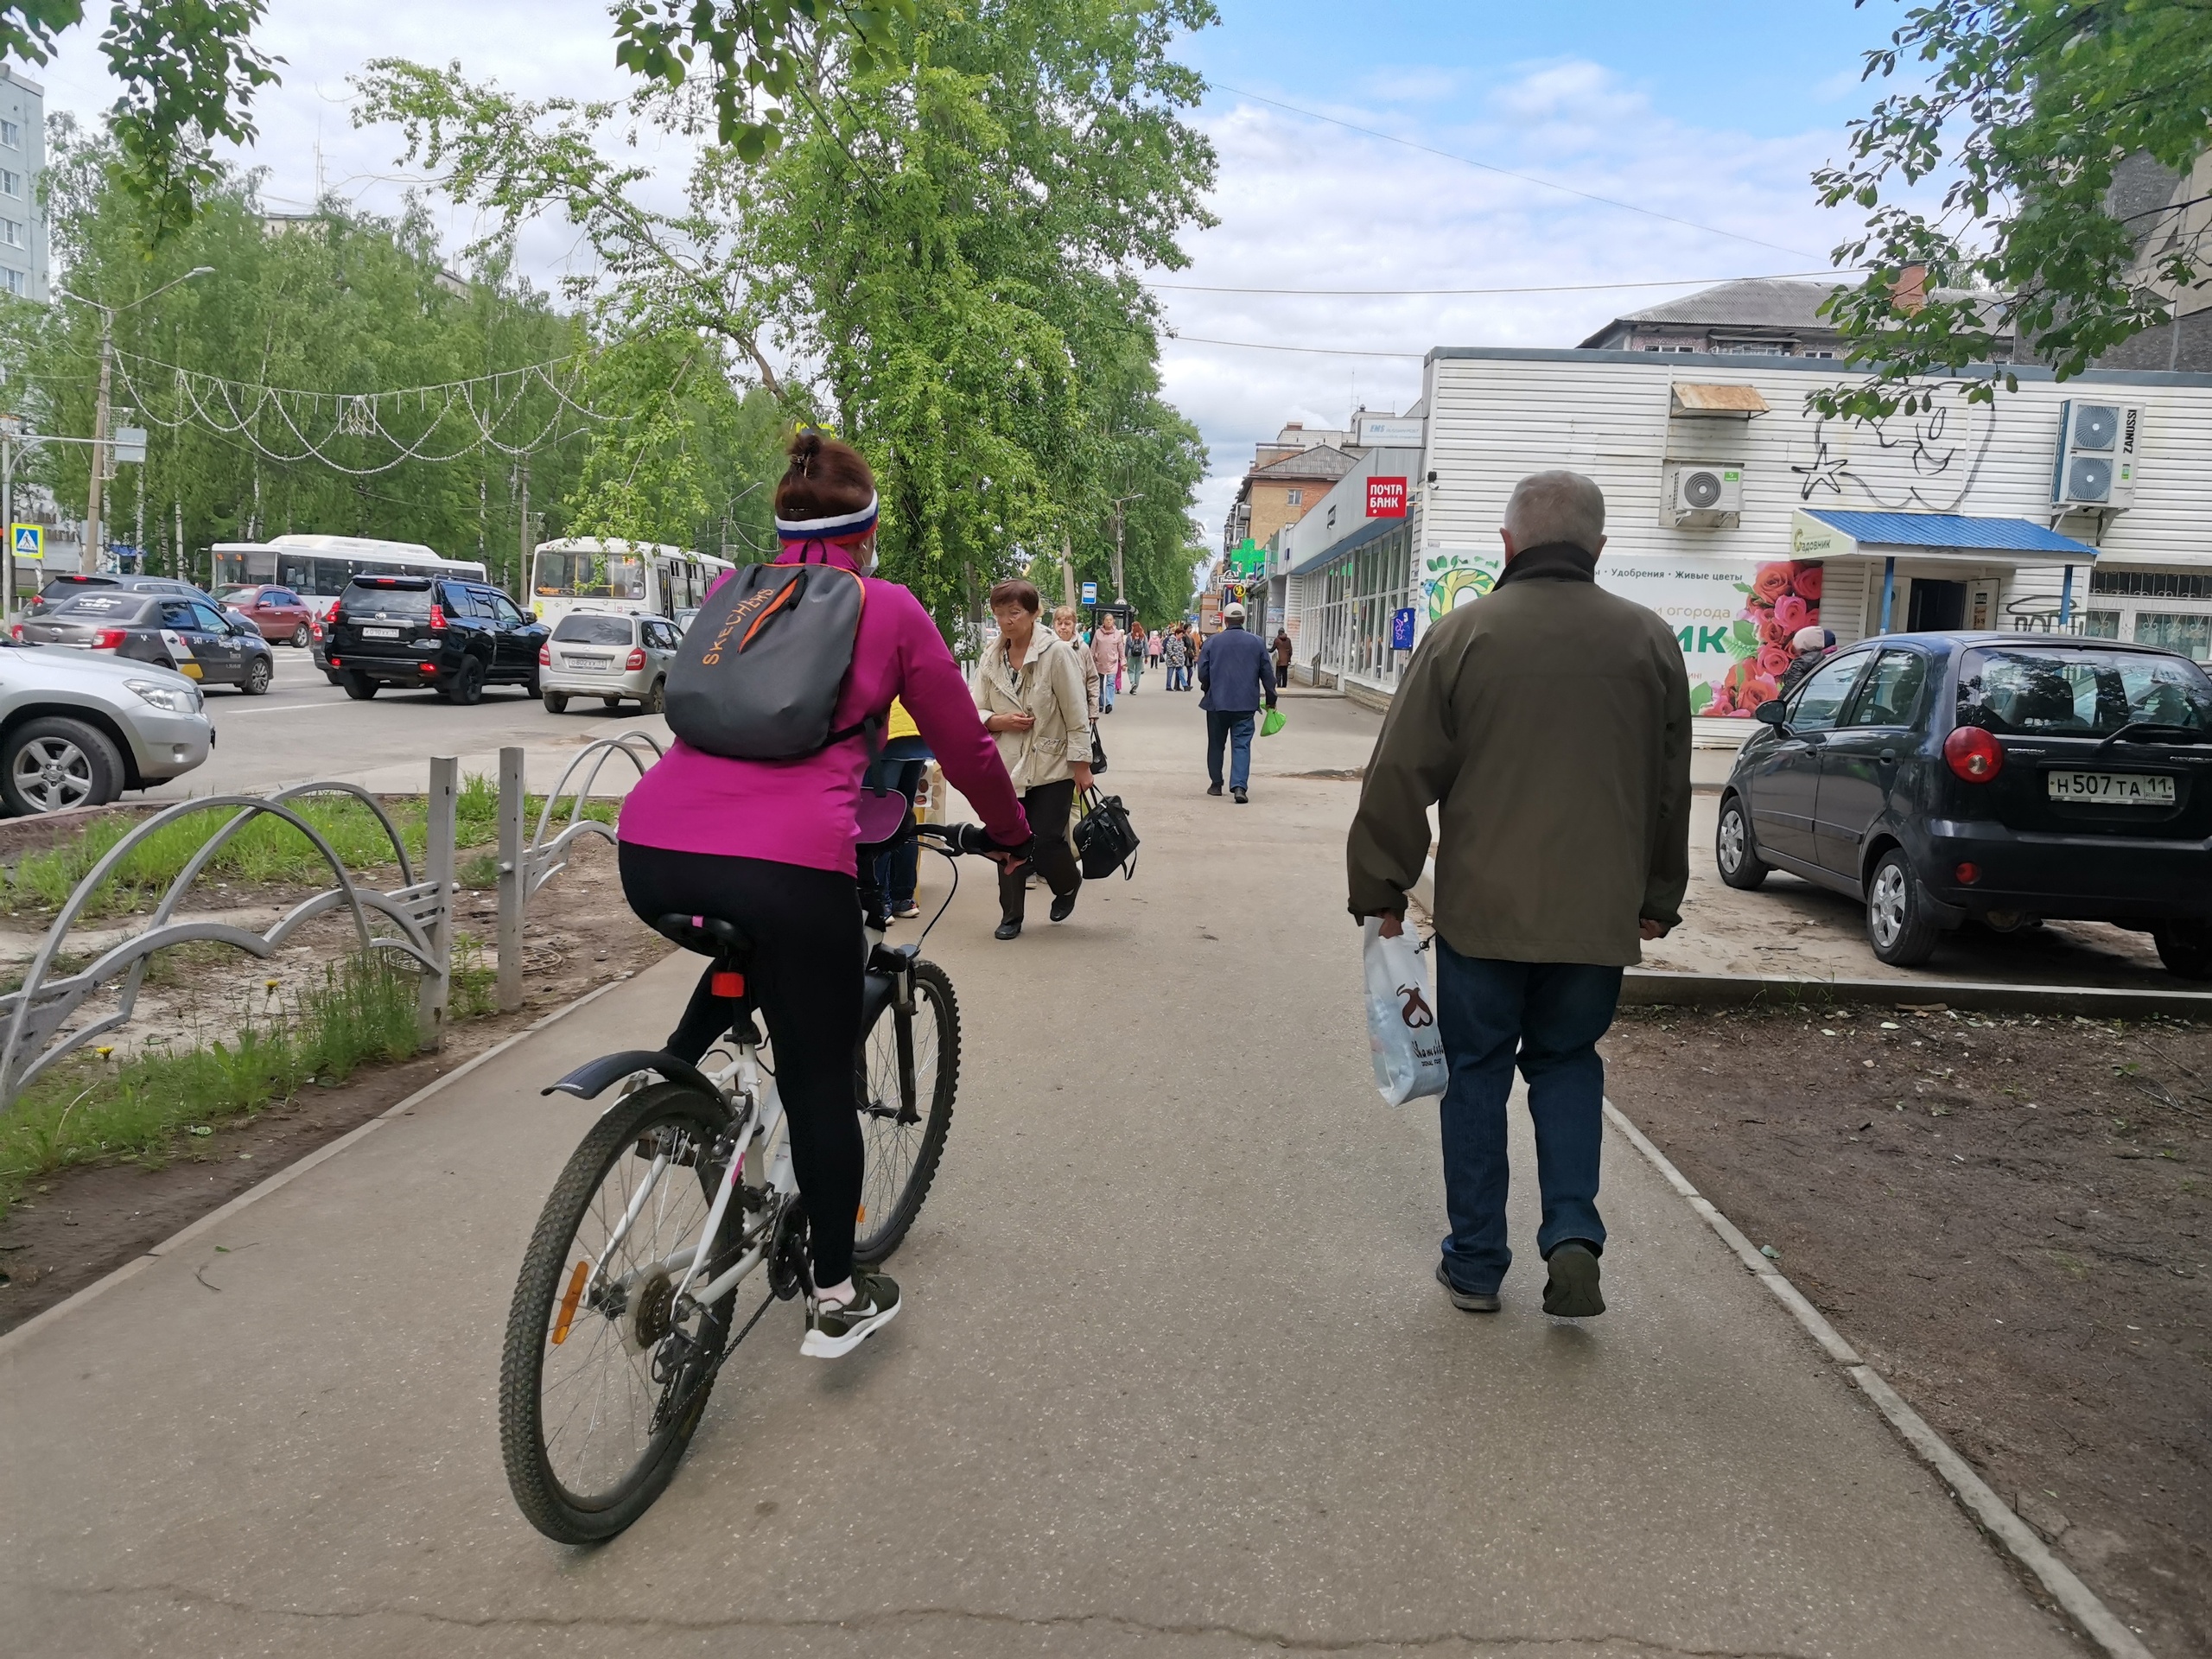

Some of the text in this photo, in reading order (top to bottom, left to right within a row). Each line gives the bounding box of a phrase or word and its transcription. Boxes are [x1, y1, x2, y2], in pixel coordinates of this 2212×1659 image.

[2123, 410, 2137, 454] ZANUSSI
[1370, 484, 1402, 495] ПОЧТА
[1370, 497, 1398, 507] БАНК
[1611, 569, 1664, 579] Удобрения
[1675, 570, 1709, 580] Живые
[1713, 573, 1743, 582] цветы
[1667, 607, 1731, 620] огорода
[702, 588, 776, 664] SKECHERS
[2147, 777, 2166, 792] 11
